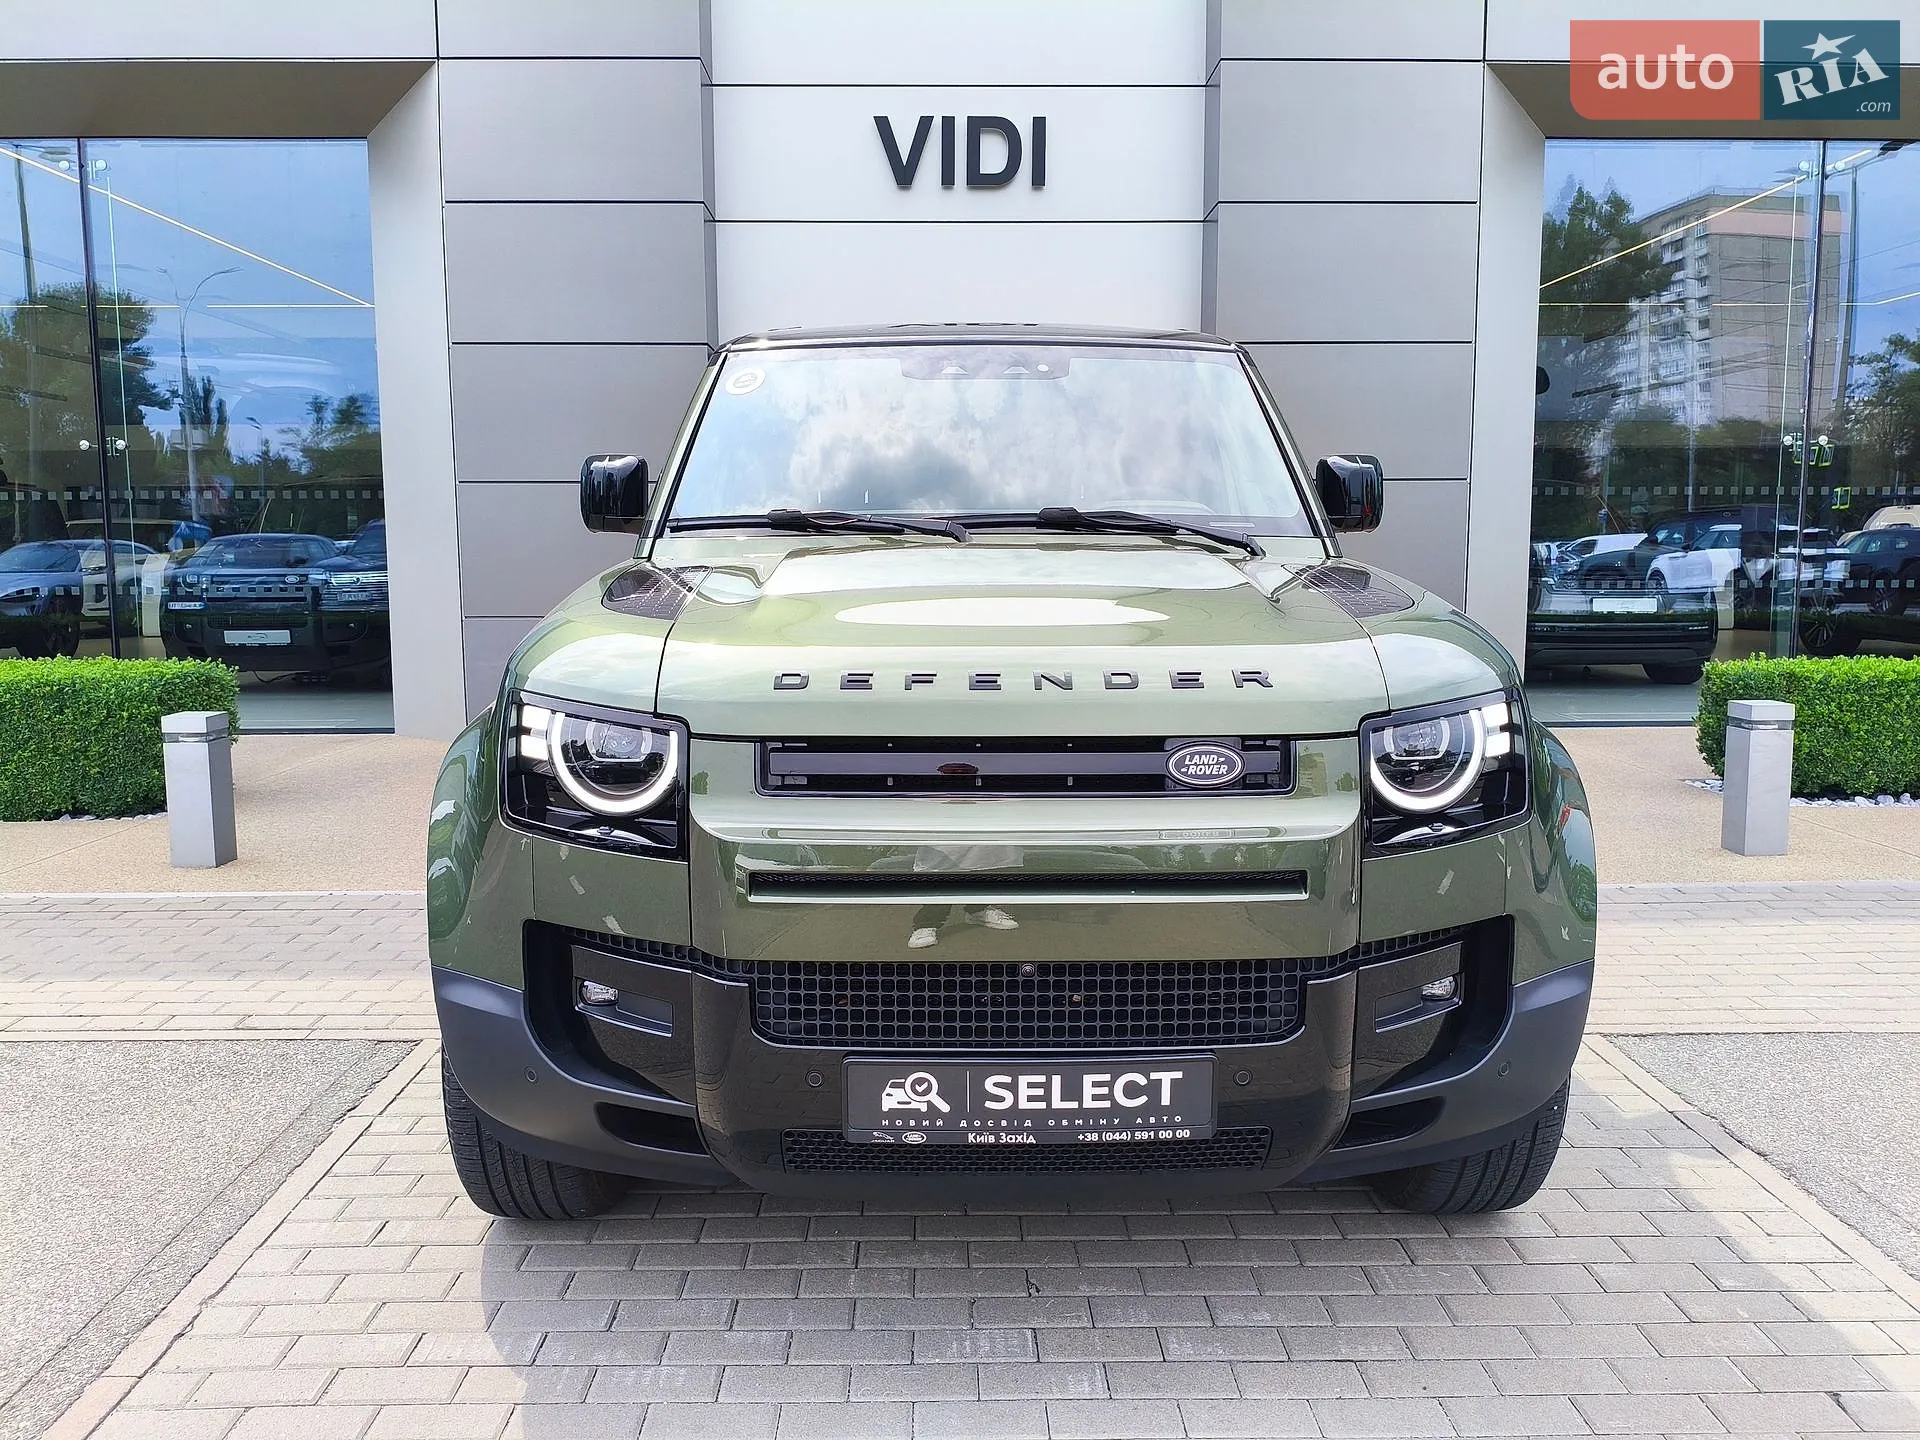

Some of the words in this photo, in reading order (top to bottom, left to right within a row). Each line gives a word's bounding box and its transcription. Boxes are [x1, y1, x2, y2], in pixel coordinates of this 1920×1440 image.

[873, 115, 1047, 188] VIDI
[773, 668, 1274, 691] DEFENDER
[1184, 754, 1218, 765] LAND
[1187, 764, 1229, 775] ROVER
[983, 1070, 1184, 1111] SELECT
[881, 1118, 944, 1127] НОВИЙ
[959, 1118, 1032, 1128] ДОСВІД
[1047, 1117, 1120, 1127] ОБМІНУ
[1135, 1115, 1183, 1125] АВТО
[967, 1131, 996, 1144] Київ
[1077, 1131, 1099, 1142] +38
[1101, 1130, 1131, 1142] (044)
[1134, 1130, 1154, 1140] 591
[1158, 1129, 1173, 1139] 00
[1175, 1129, 1191, 1138] 00
